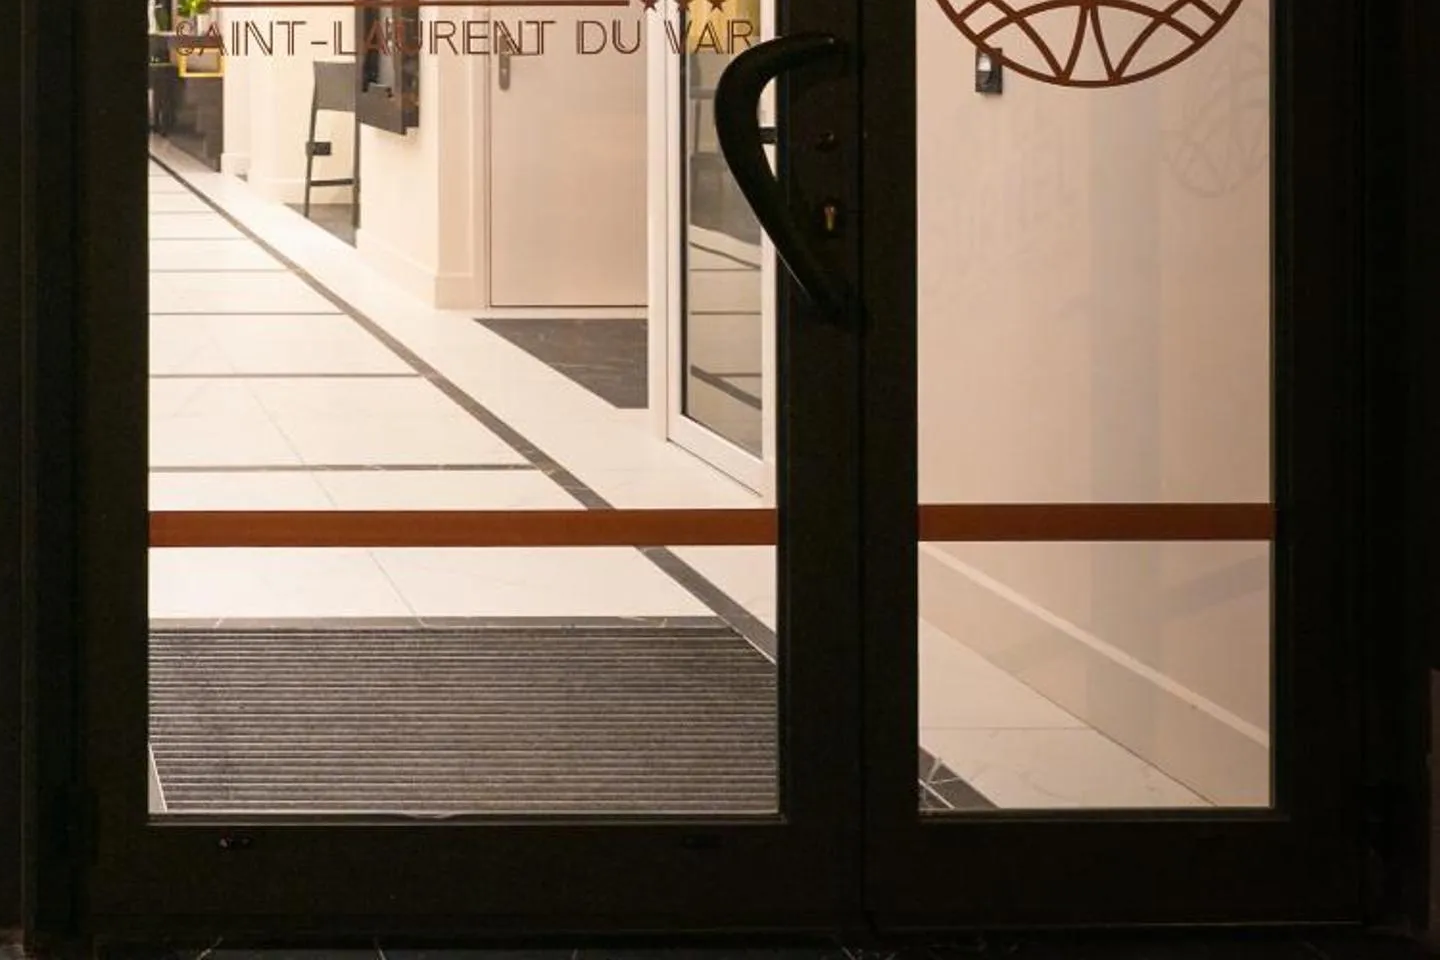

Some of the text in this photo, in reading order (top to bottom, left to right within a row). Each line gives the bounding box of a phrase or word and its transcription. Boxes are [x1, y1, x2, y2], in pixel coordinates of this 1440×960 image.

[176, 20, 754, 56] SAINT-LAURENT DU VAR
